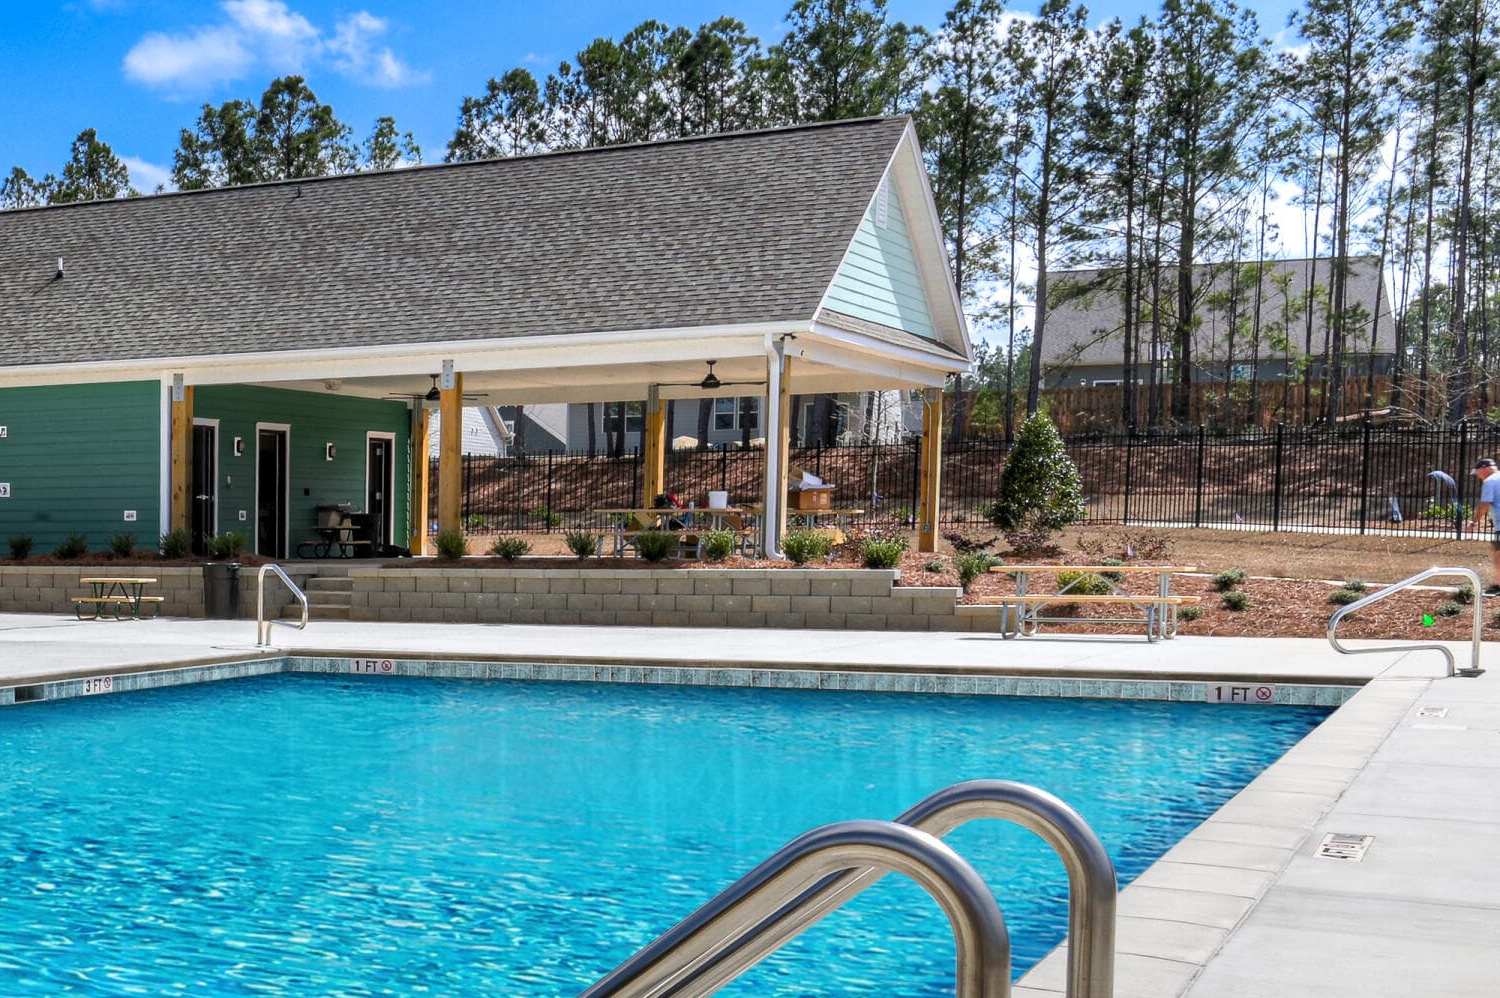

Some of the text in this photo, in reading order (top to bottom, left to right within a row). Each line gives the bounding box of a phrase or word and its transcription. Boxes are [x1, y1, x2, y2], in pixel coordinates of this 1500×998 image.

[355, 660, 378, 673] 1 FT
[85, 678, 102, 693] 3 FT
[1215, 686, 1250, 702] 1 FT
